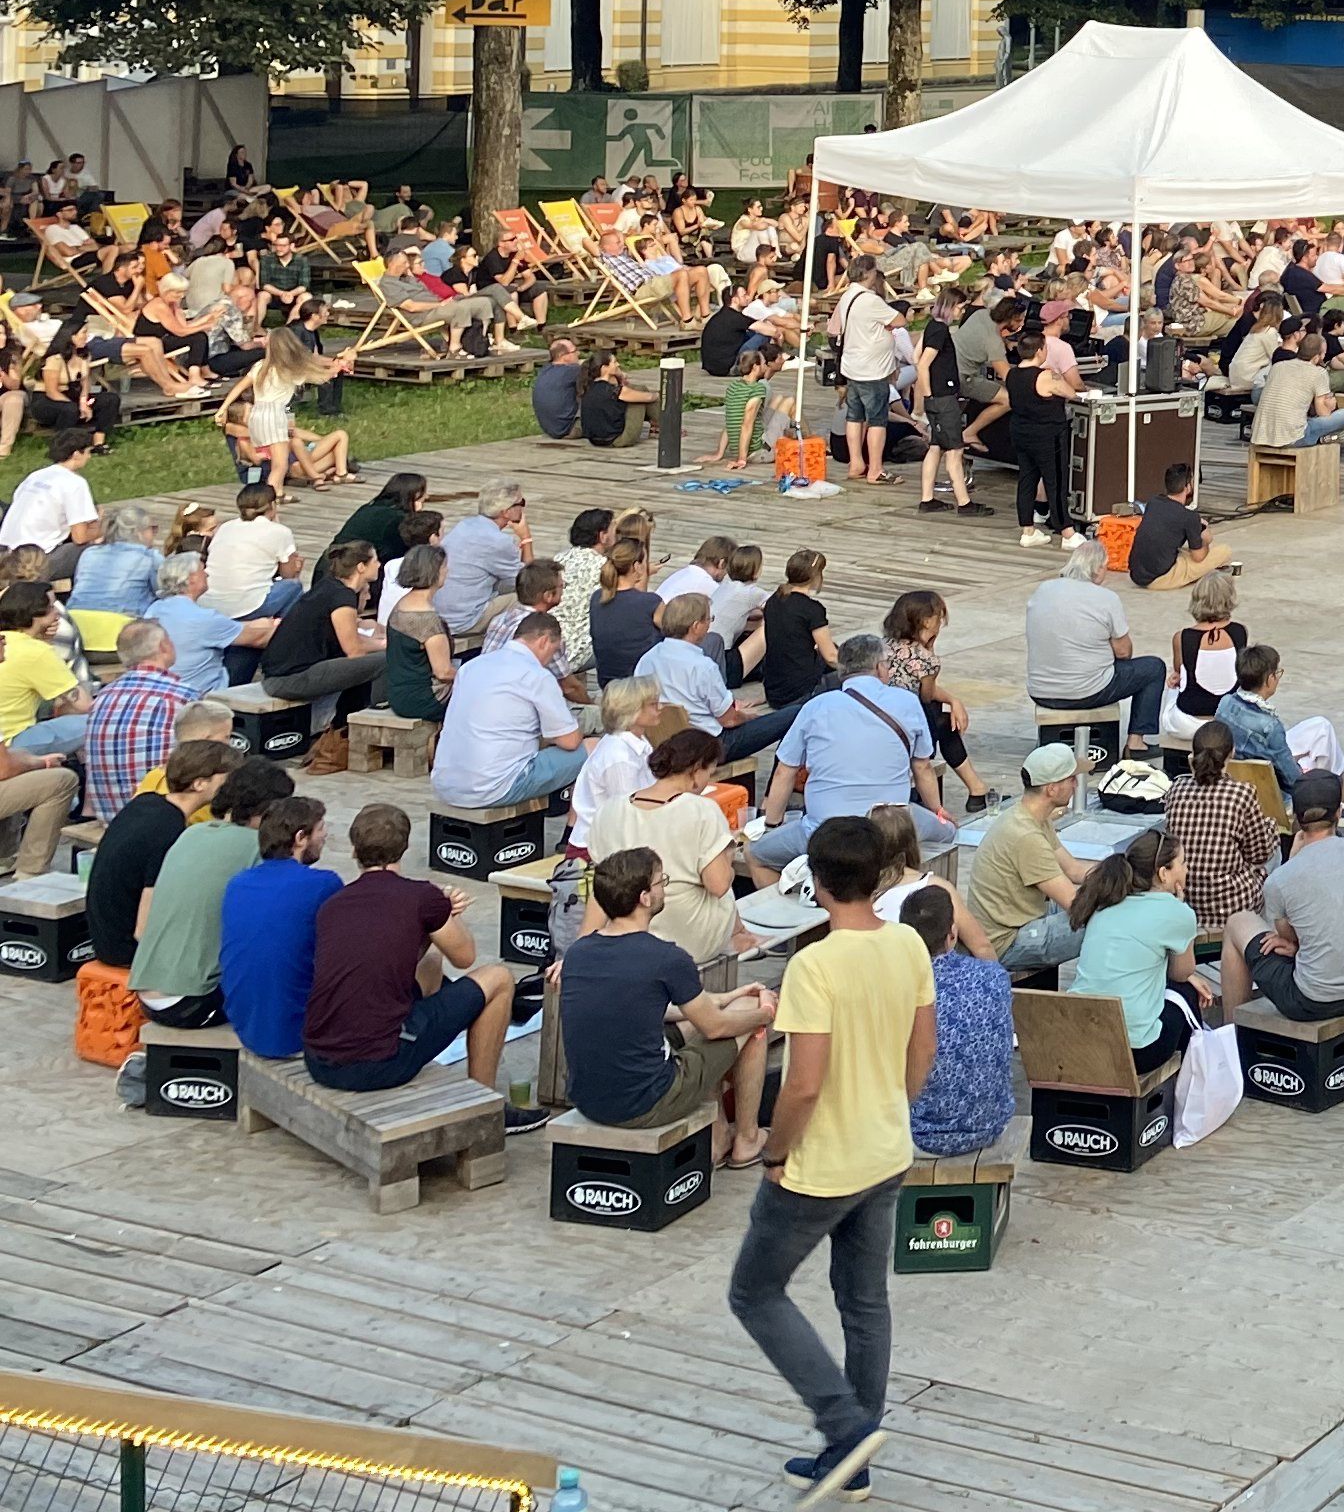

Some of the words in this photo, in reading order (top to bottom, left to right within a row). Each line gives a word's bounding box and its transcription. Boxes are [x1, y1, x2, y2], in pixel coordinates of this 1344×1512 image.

[449, 848, 473, 864] RAUCH
[505, 845, 531, 859] RAUCH
[524, 938, 550, 951] RAUC
[9, 948, 40, 964] RAUCH
[1262, 1068, 1298, 1092] RAUCH
[179, 1085, 224, 1102] RAUCH
[1065, 1131, 1110, 1151] RAUCH
[585, 1190, 633, 1210] RAUCH
[909, 1238, 977, 1250] fohrenburger
